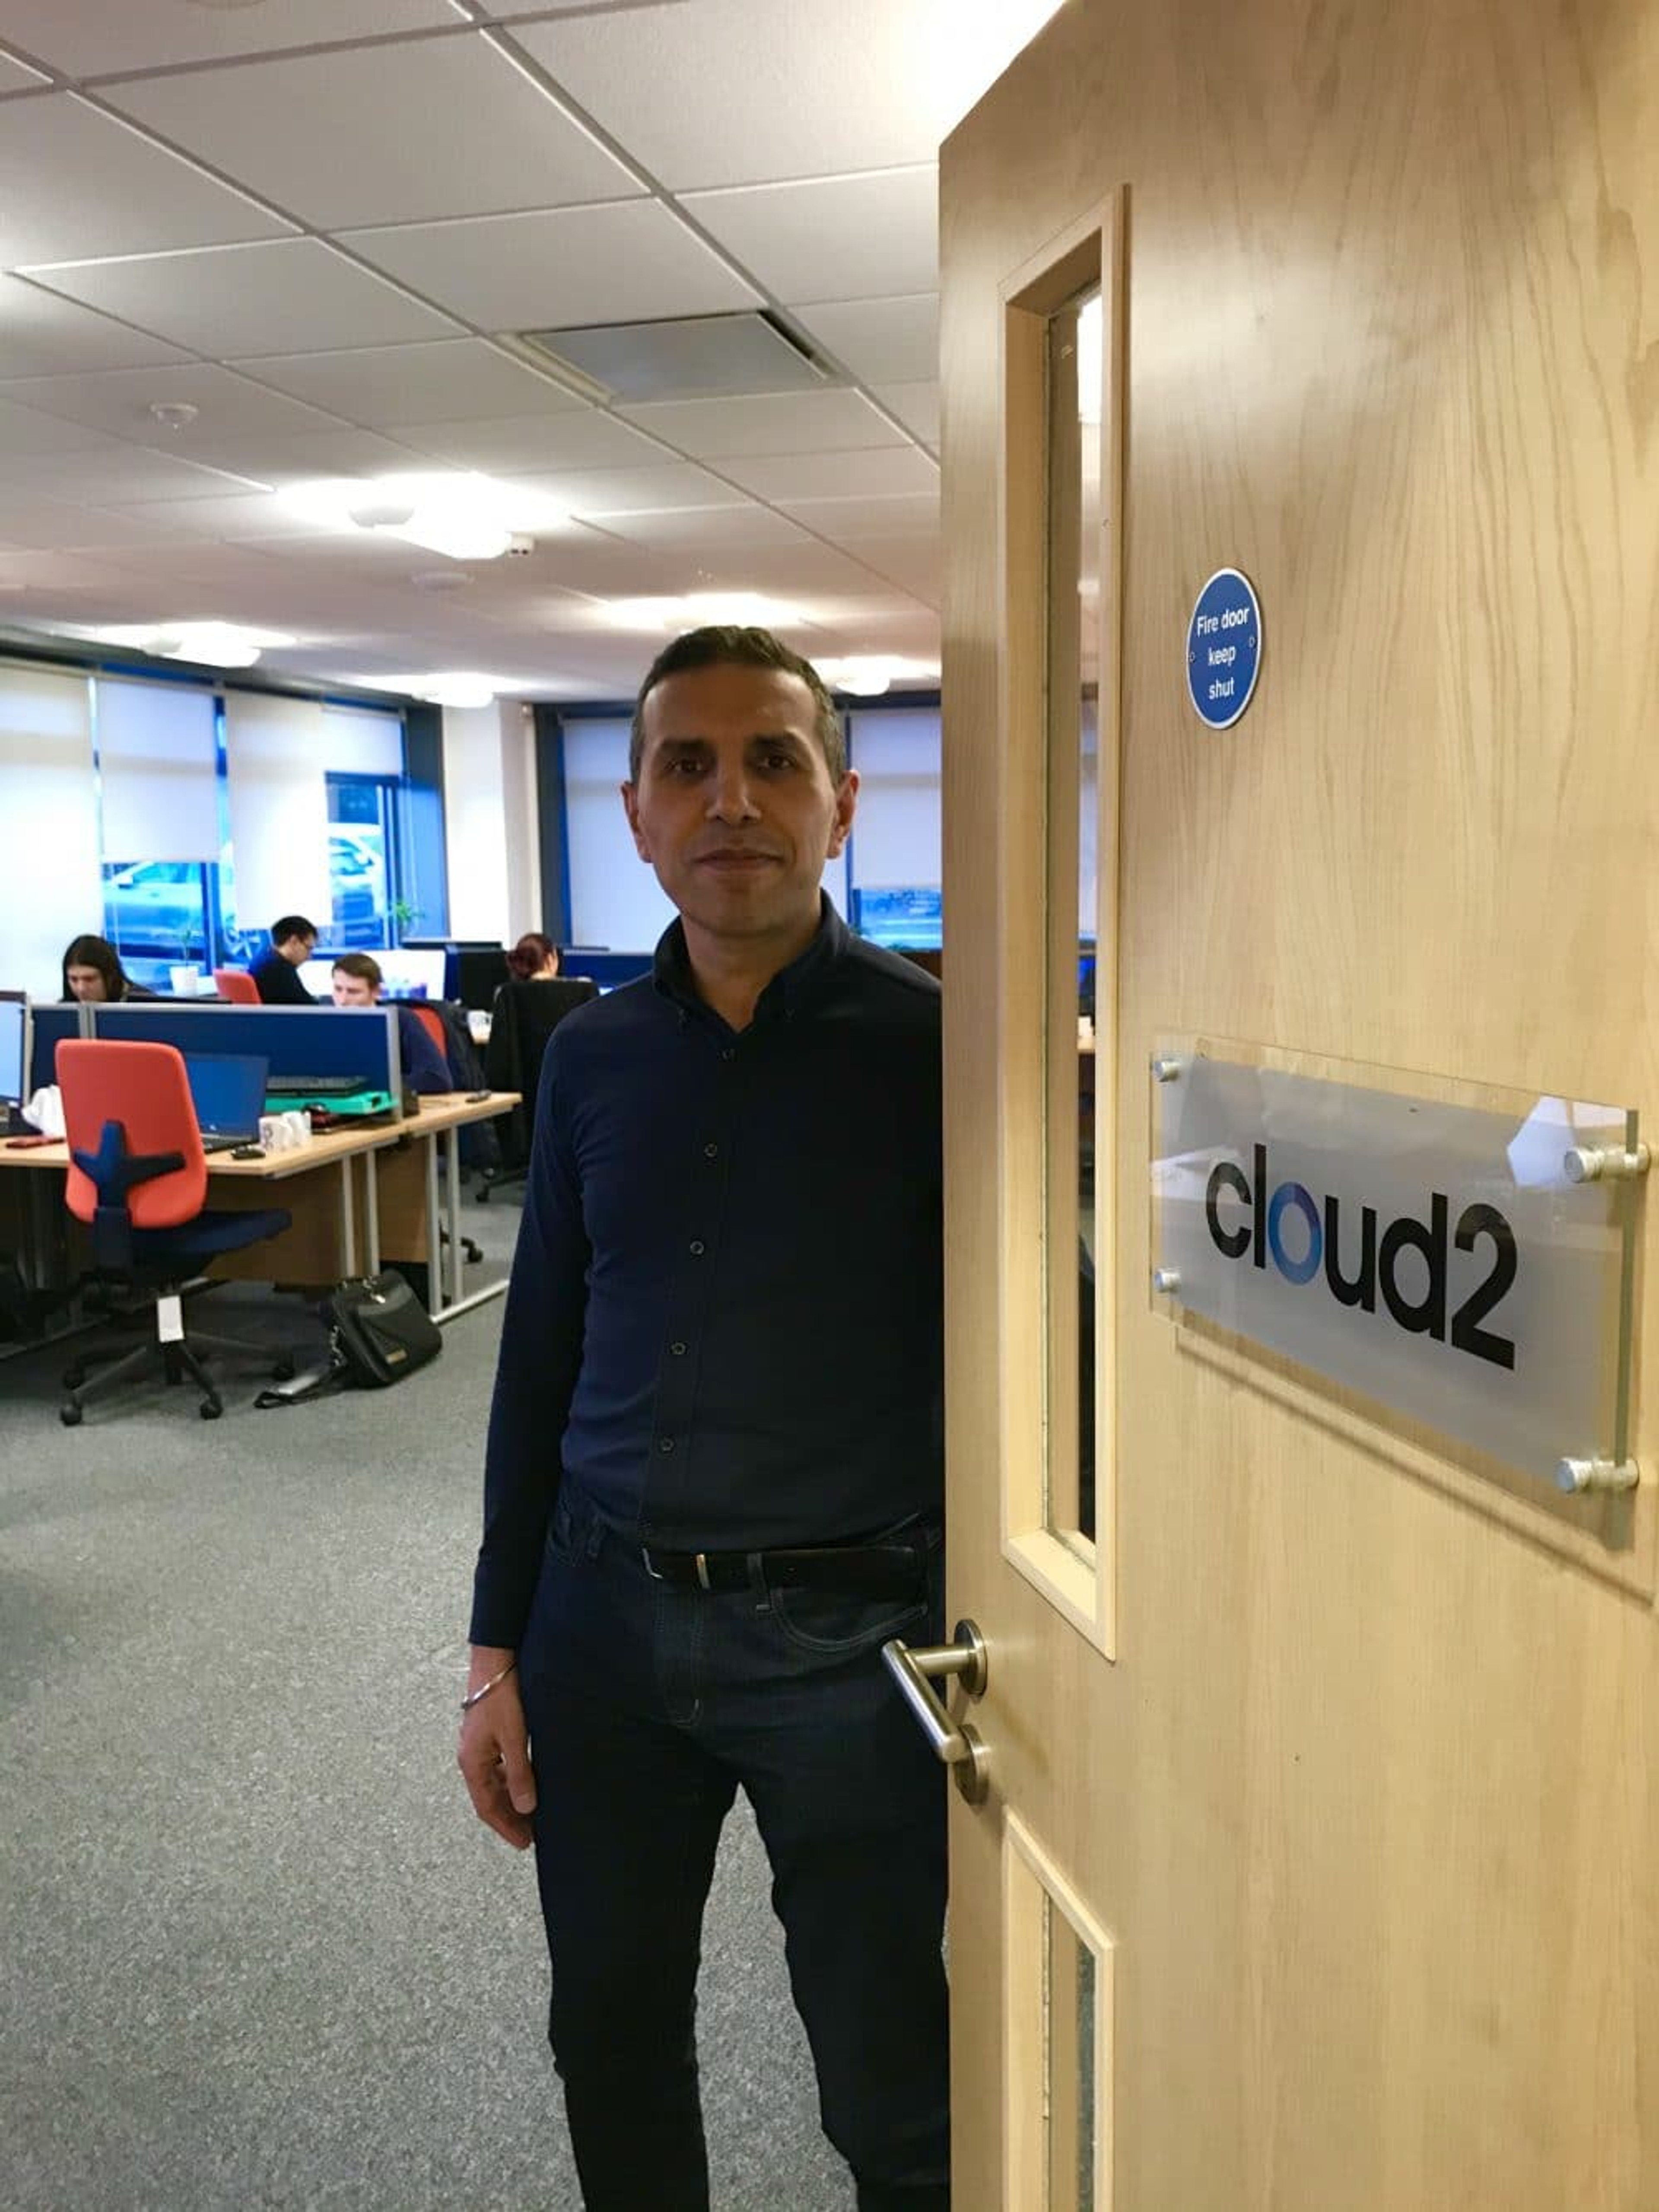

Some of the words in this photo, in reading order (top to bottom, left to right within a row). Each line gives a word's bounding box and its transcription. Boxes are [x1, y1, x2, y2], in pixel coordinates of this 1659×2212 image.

[1197, 615, 1219, 637] Fire
[1221, 607, 1250, 629] door
[1208, 646, 1236, 666] keep
[1209, 677, 1235, 699] shut
[1206, 1143, 1517, 1371] cloud2
